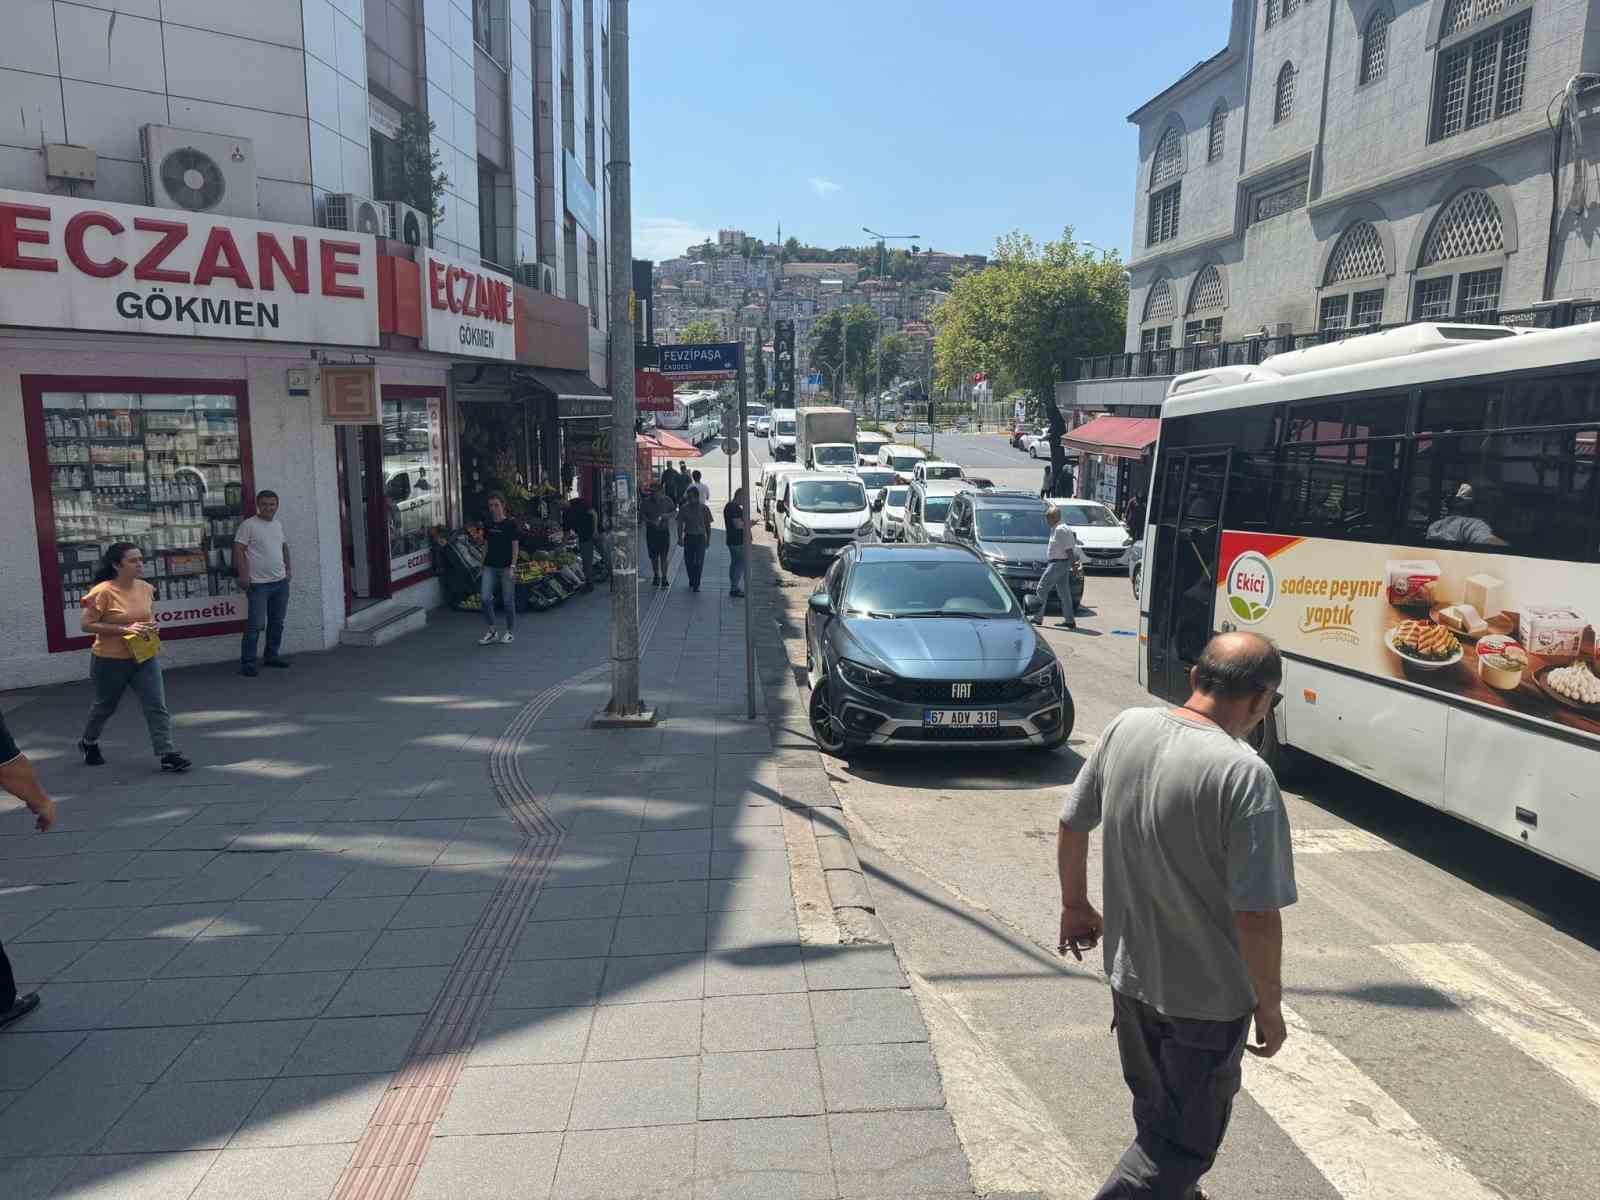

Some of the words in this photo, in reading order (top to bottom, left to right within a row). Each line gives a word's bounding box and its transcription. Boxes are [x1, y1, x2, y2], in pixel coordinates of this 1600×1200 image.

[0, 202, 365, 299] ECZANE
[429, 257, 513, 325] ECZANE
[115, 287, 280, 328] GÖKMEN
[459, 322, 494, 349] GÖKMEN
[1236, 572, 1265, 593] Ekici
[1280, 576, 1328, 595] sadece
[1304, 604, 1354, 627] yaptık
[951, 683, 972, 698] FIAT
[931, 712, 944, 723] 67
[976, 712, 996, 723] 318
